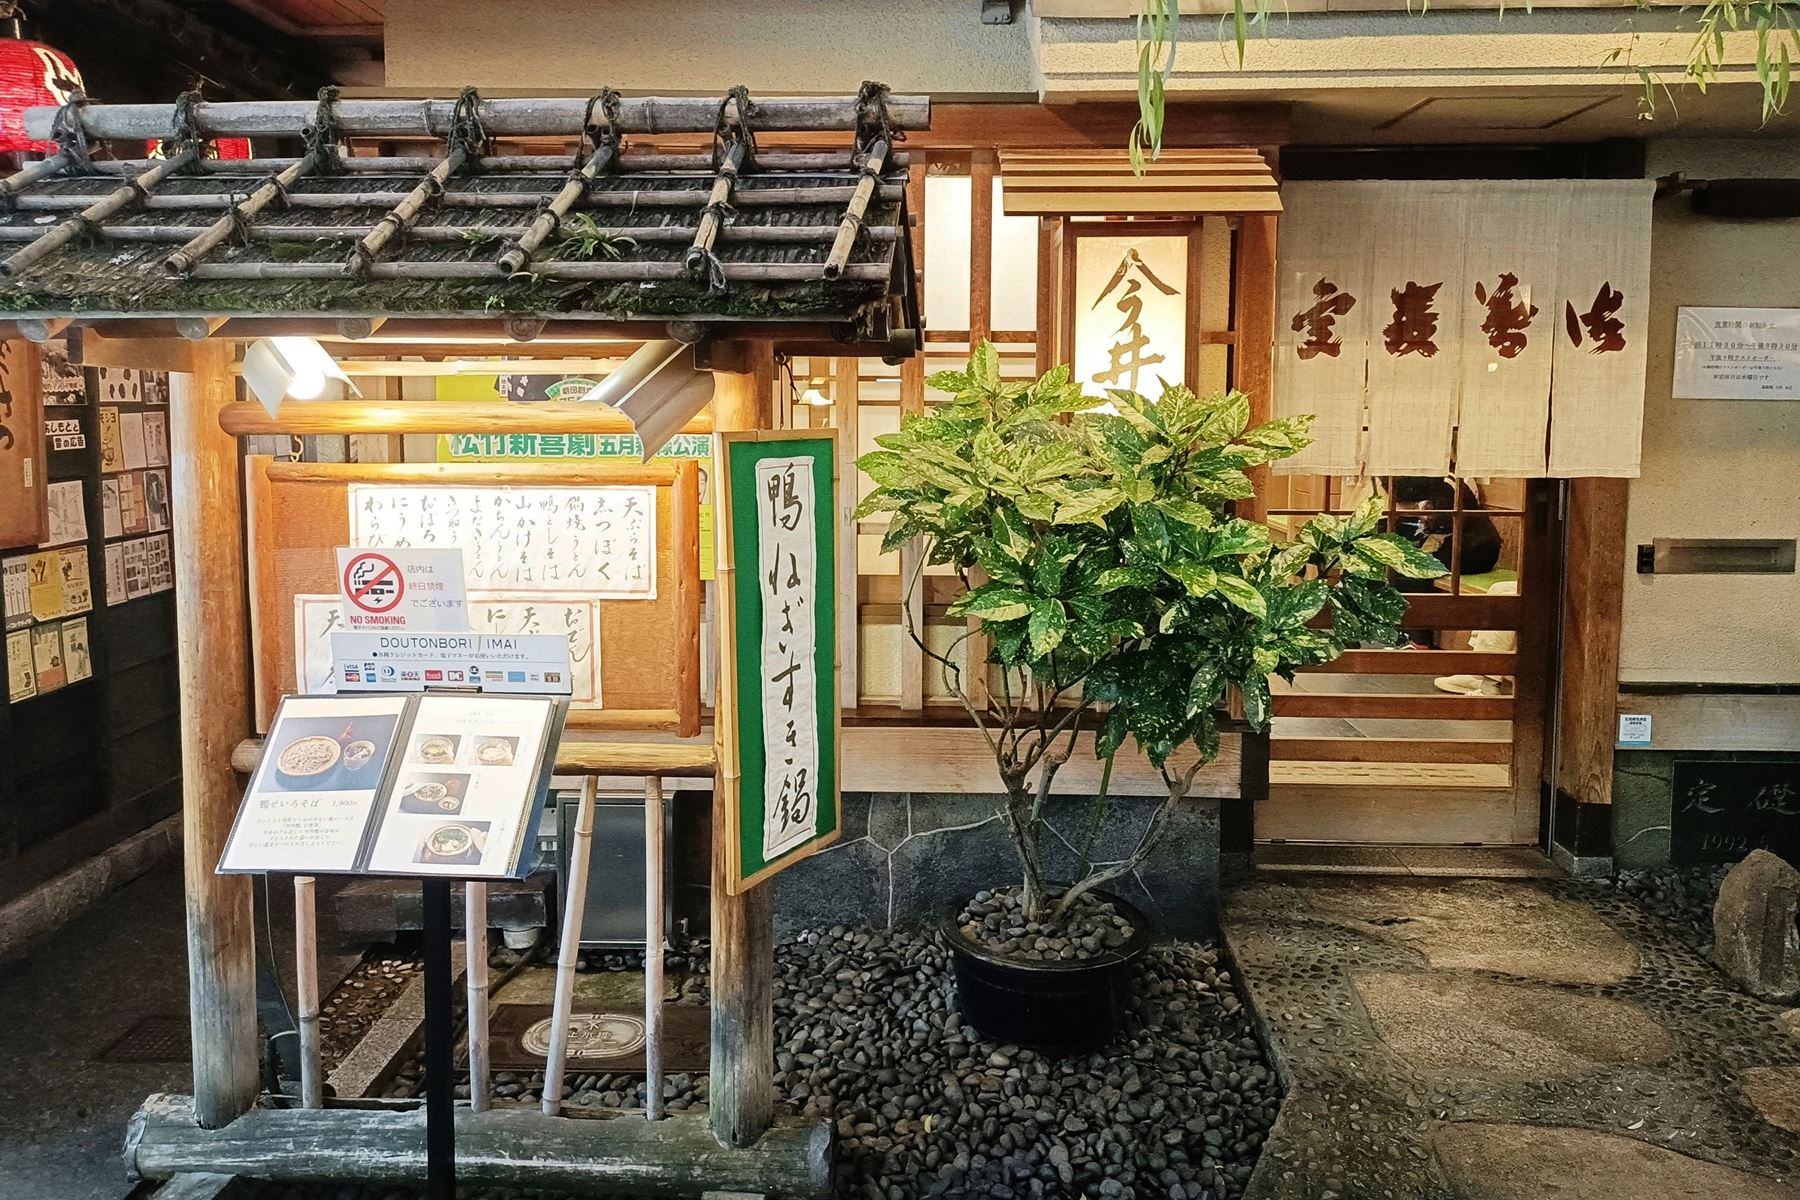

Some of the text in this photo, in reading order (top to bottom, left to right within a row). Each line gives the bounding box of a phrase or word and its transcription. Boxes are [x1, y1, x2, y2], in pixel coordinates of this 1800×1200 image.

[1092, 248, 1181, 391] 今井
[451, 434, 596, 456] 松竹新喜劇
[407, 565, 434, 573] 店内は
[409, 582, 444, 591] 終日禁煙
[411, 599, 463, 608] でございます
[350, 615, 406, 625] NO SMOKING
[380, 637, 517, 650] DOUTONBORI IMAI
[1702, 834, 1748, 850] 1992
